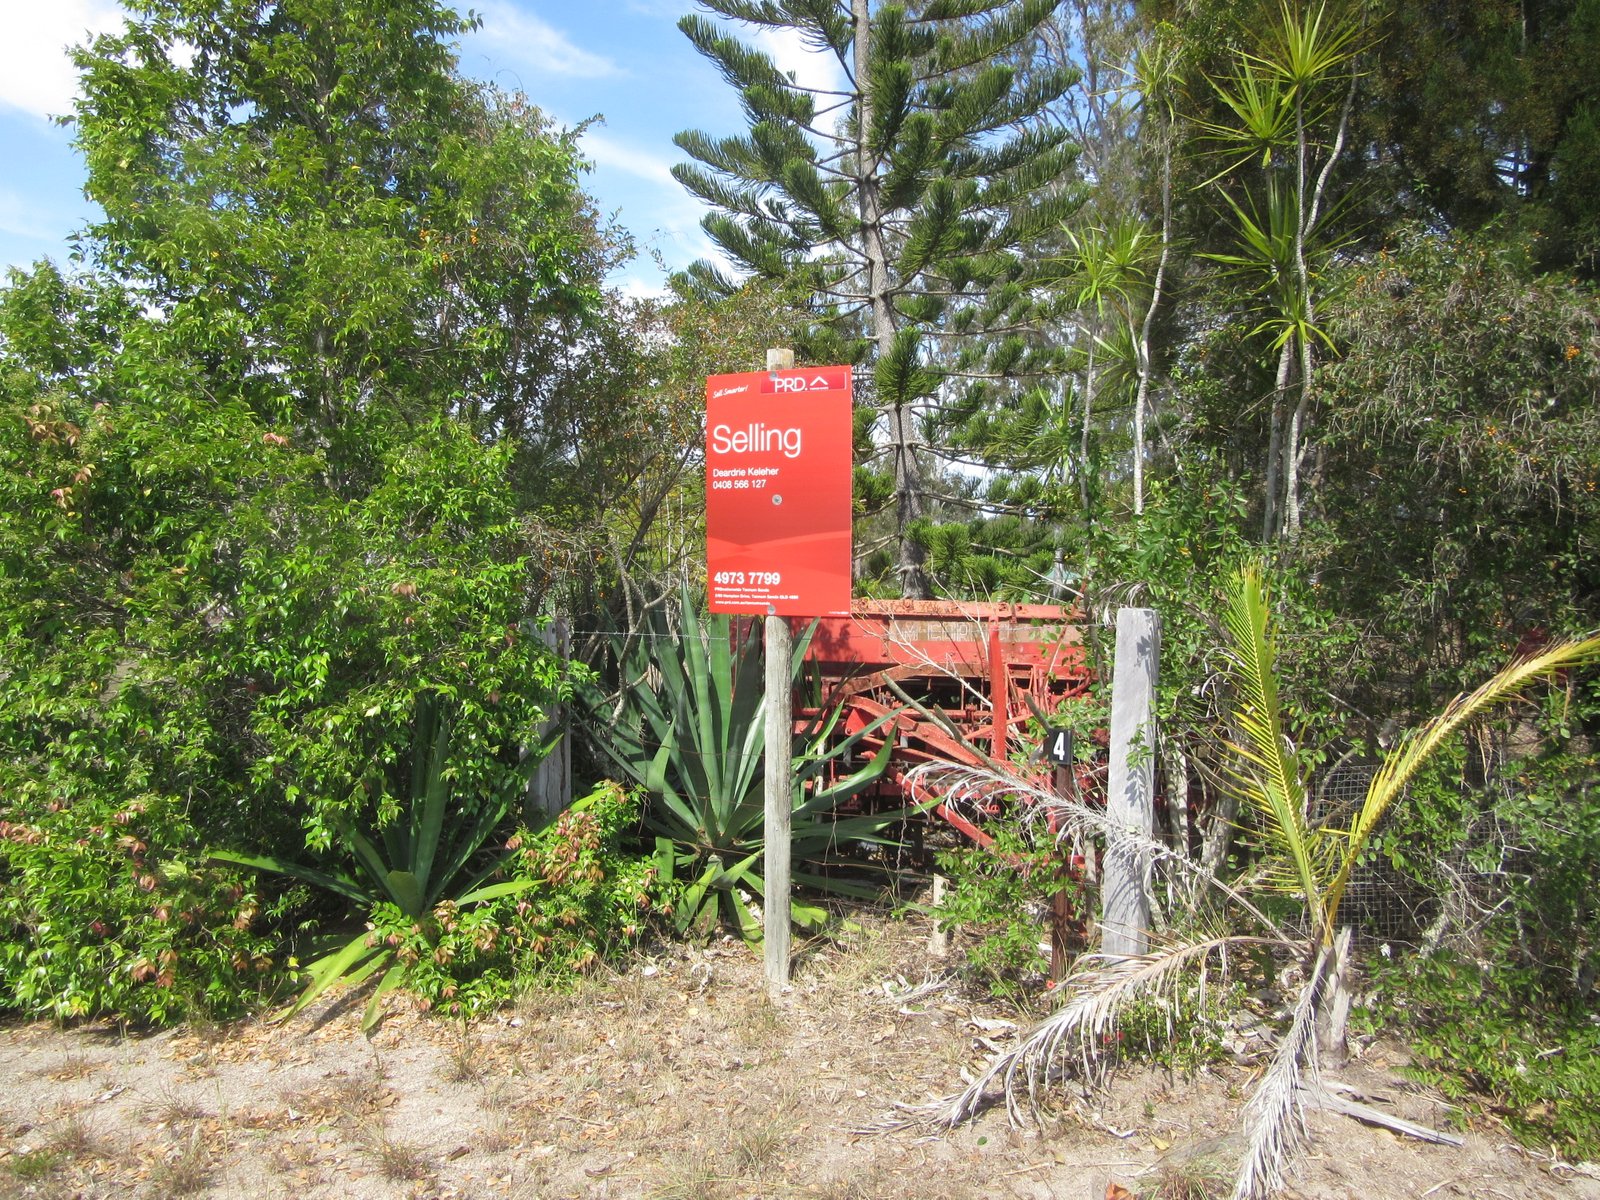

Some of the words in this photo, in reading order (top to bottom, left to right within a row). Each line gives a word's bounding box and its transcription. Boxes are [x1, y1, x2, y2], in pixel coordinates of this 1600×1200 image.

[712, 423, 801, 458] Selling
[712, 480, 733, 489] 0408
[734, 480, 749, 489] 566
[751, 479, 767, 489] 127
[714, 571, 745, 585] 4973
[748, 572, 781, 585] 7799
[1053, 731, 1065, 761] 4
